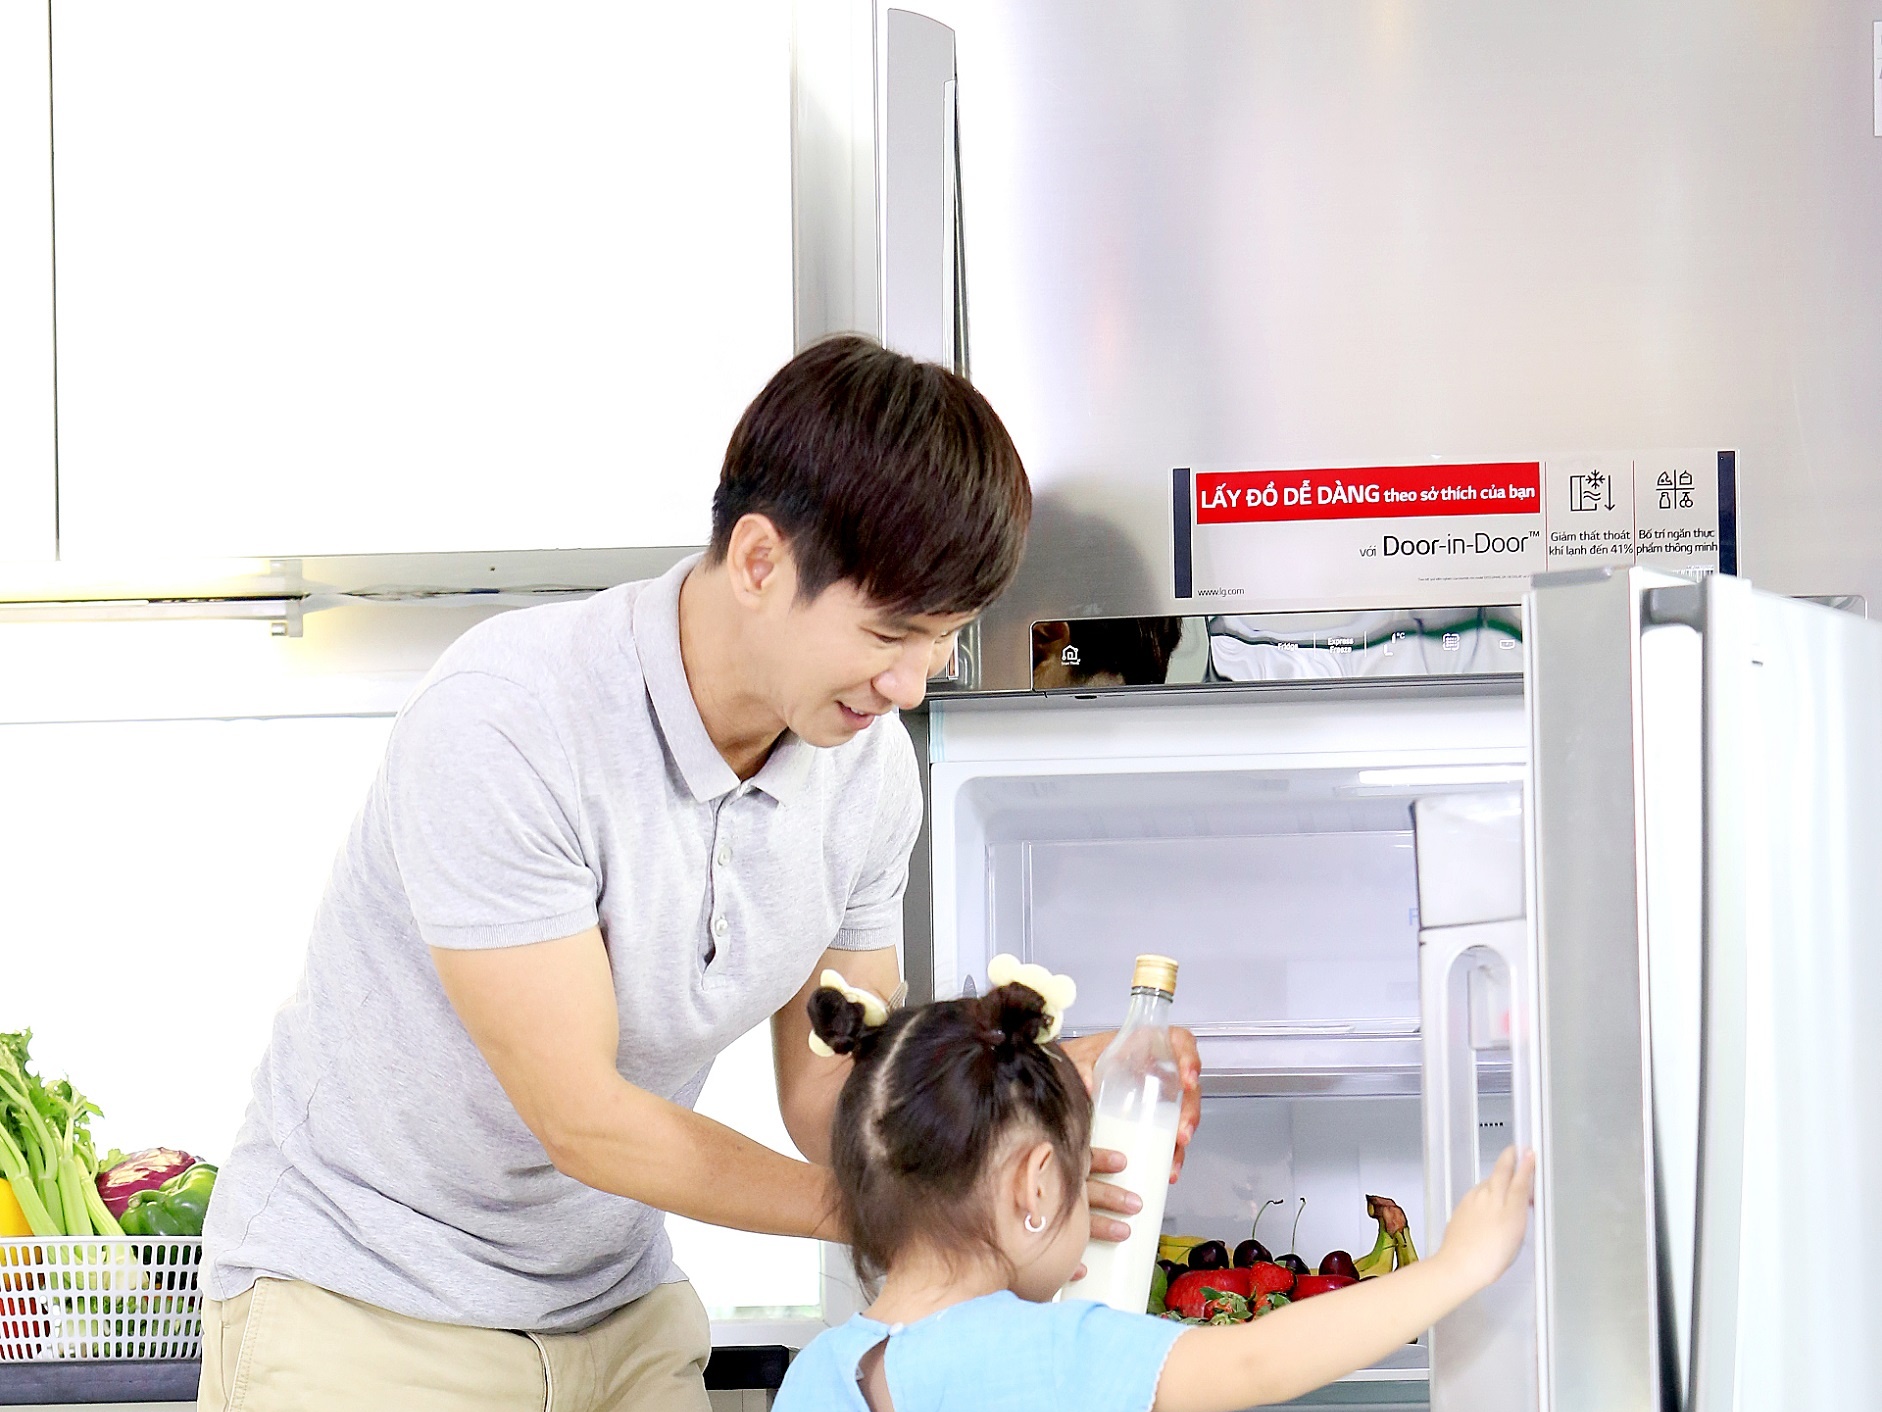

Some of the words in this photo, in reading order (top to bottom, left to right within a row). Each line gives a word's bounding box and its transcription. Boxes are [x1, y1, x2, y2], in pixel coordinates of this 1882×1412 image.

[1201, 482, 1242, 509] LẤY
[1246, 480, 1279, 508] ĐỒ
[1283, 479, 1312, 506] DỄ
[1317, 479, 1380, 505] DÀNG
[1383, 488, 1417, 502] theo
[1420, 485, 1439, 501] sở
[1440, 485, 1477, 501] thích
[1480, 484, 1506, 500] của
[1509, 483, 1535, 501] bạn
[1579, 530, 1600, 541] thất
[1603, 529, 1631, 540] thoát
[1638, 528, 1653, 539] Bố
[1359, 545, 1377, 558] với
[1549, 545, 1564, 555] khí
[1566, 545, 1587, 556] lạnh
[1590, 543, 1608, 555] đến
[1610, 543, 1633, 554] 41%
[1664, 542, 1693, 555] thông
[1695, 541, 1718, 552] minh
[1198, 587, 1245, 598] www.lg.com
[1277, 642, 1299, 652] Fridge
[1327, 637, 1354, 646] Express
